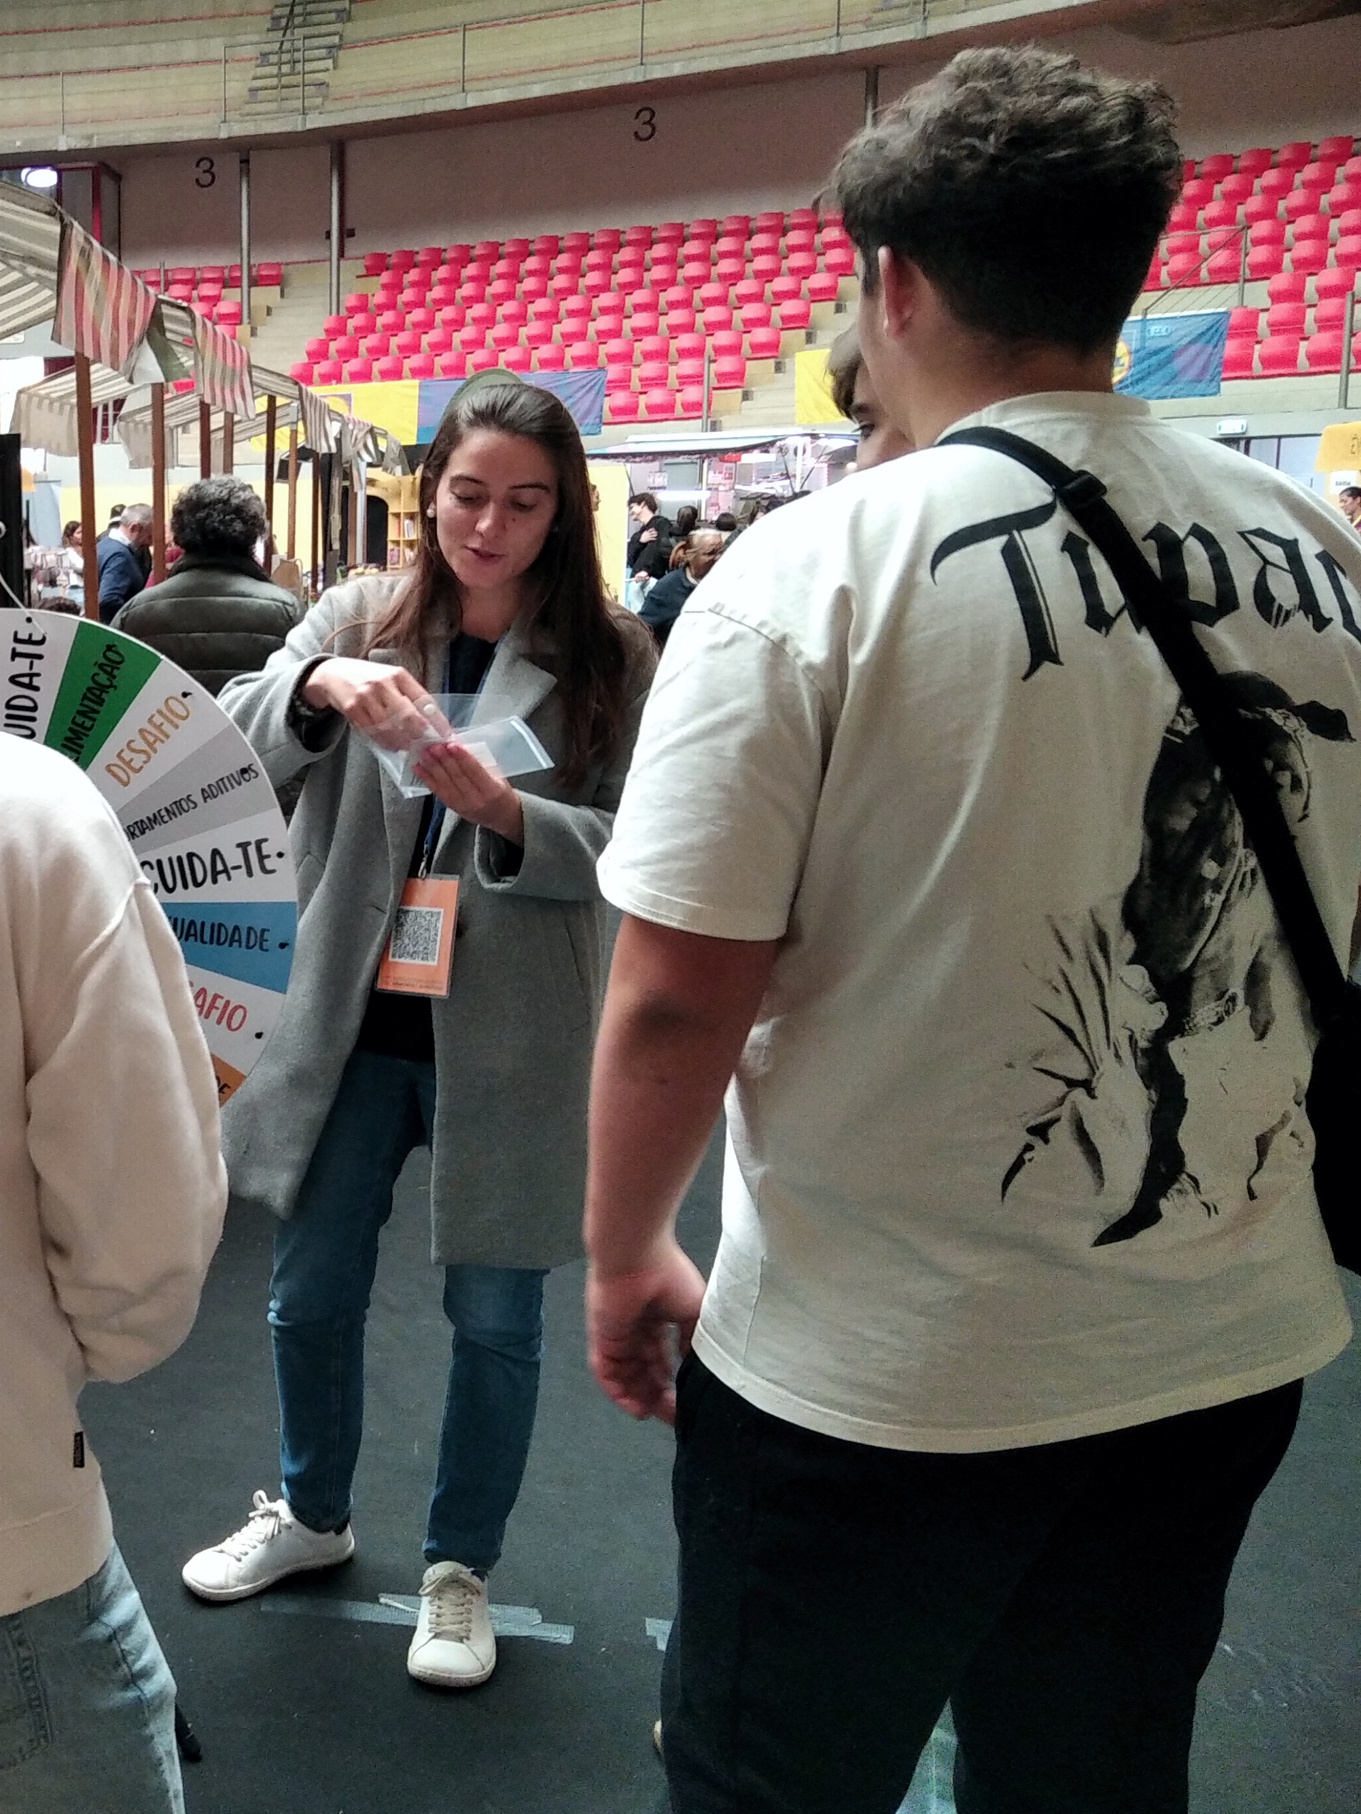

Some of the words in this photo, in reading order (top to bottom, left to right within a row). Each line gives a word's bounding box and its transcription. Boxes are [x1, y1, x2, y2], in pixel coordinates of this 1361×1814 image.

[632, 106, 658, 142] 3
[194, 156, 217, 189] 3
[60, 647, 125, 763] IMENTAÇÃO
[105, 696, 190, 788] DESAFIO
[200, 763, 259, 803] ADITIVOS
[140, 838, 278, 894] CUIDA-TE
[169, 916, 270, 952] UALIDADE
[189, 980, 248, 1032] AFIO
